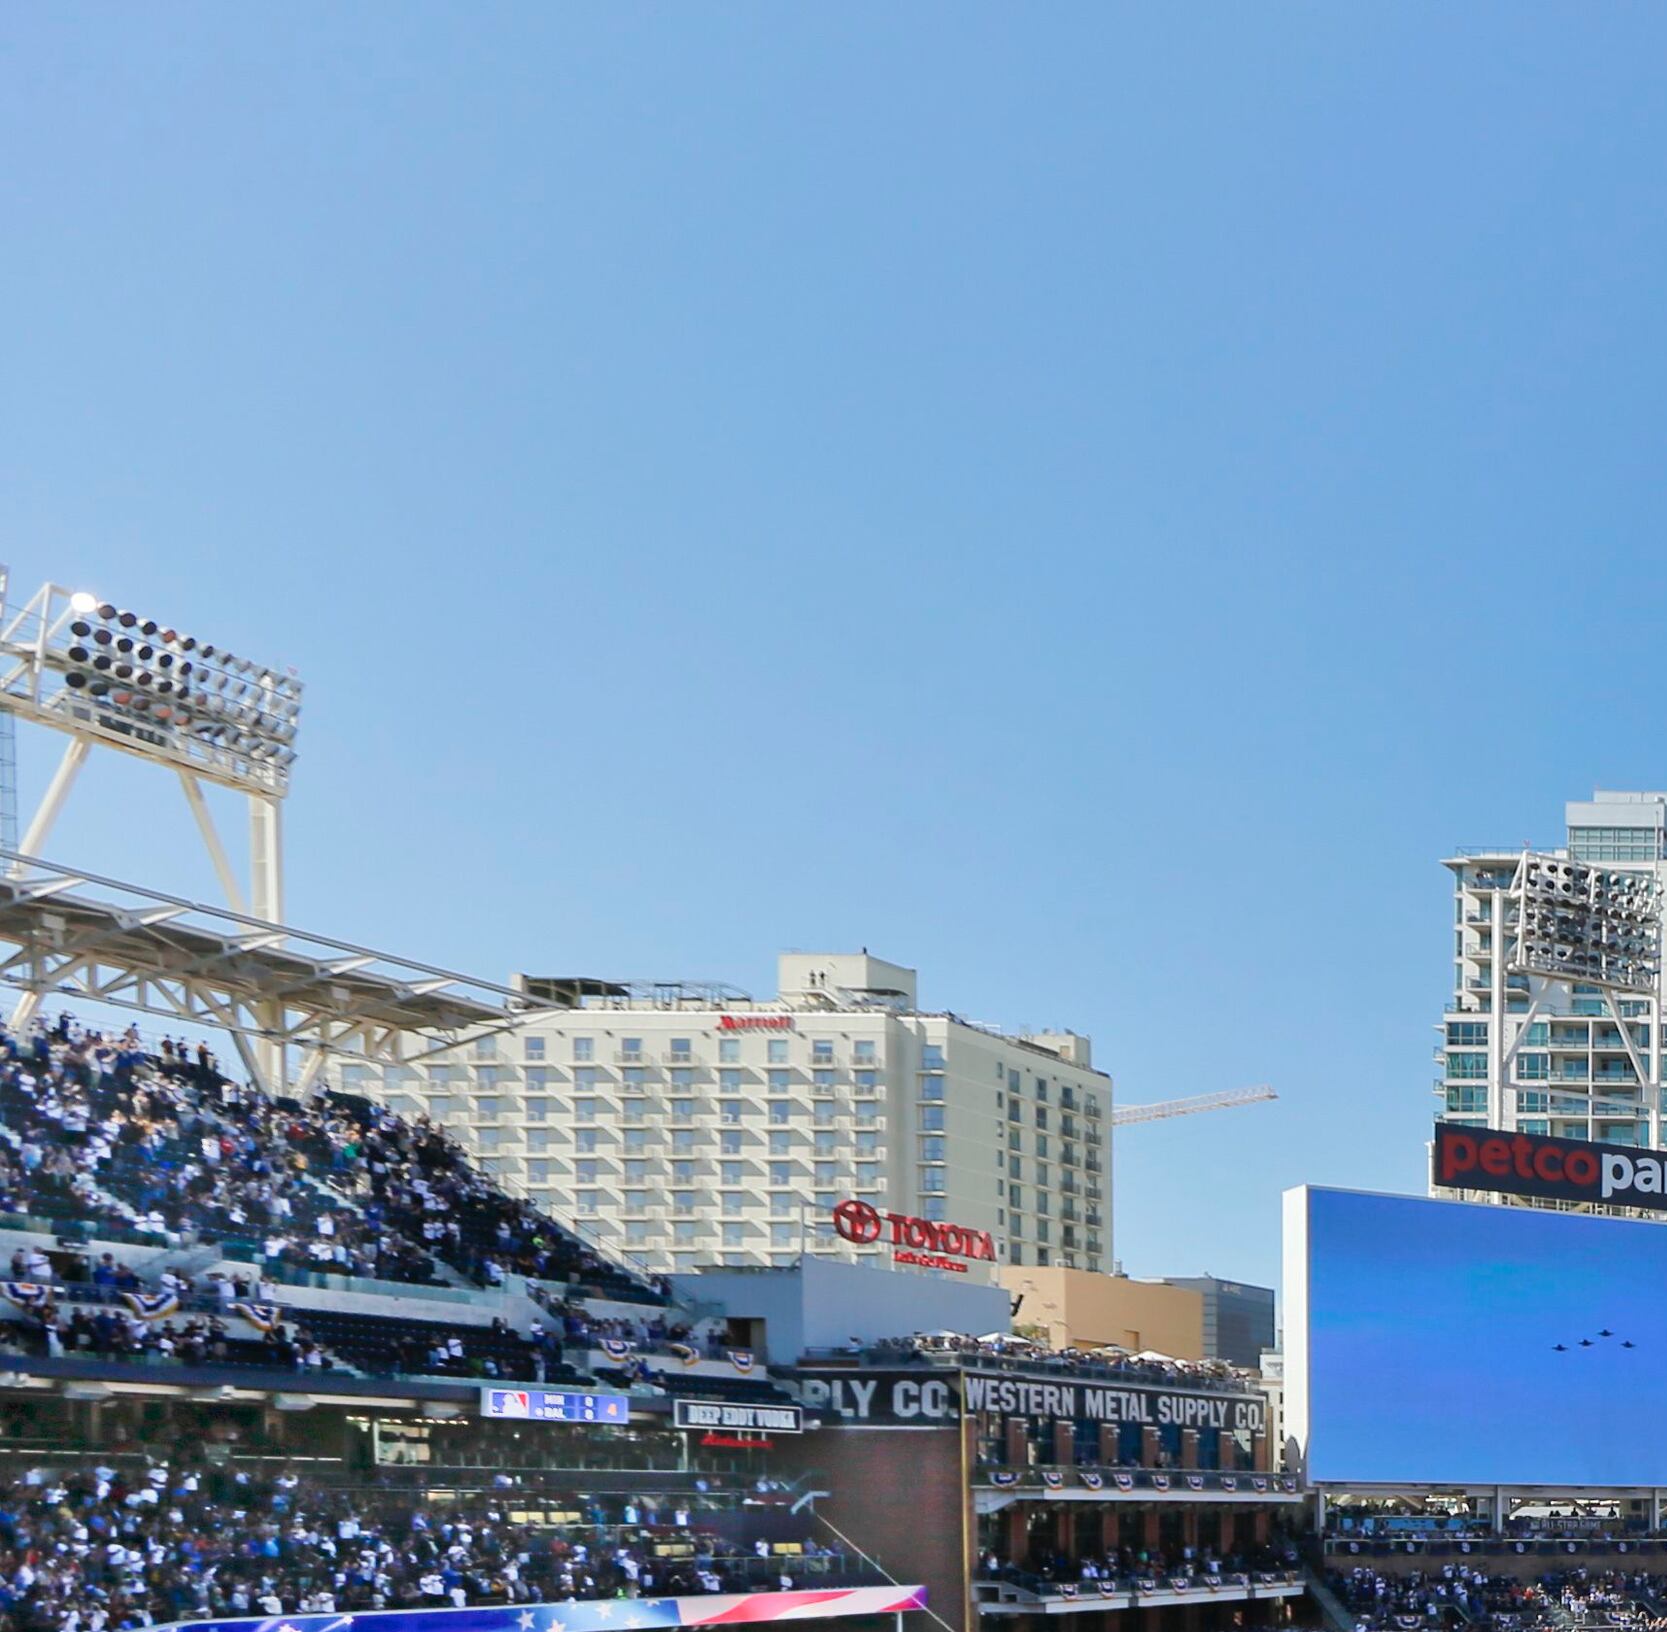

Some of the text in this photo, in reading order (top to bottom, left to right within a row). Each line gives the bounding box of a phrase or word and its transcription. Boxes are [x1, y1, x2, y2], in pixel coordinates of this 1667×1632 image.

[886, 1213, 997, 1261] TOYOTA
[687, 1404, 796, 1429] DEEP EDDY VODKA
[892, 1379, 960, 1419] CO.
[965, 1376, 1265, 1431] WESTERN METAL SUPPLY CO.
